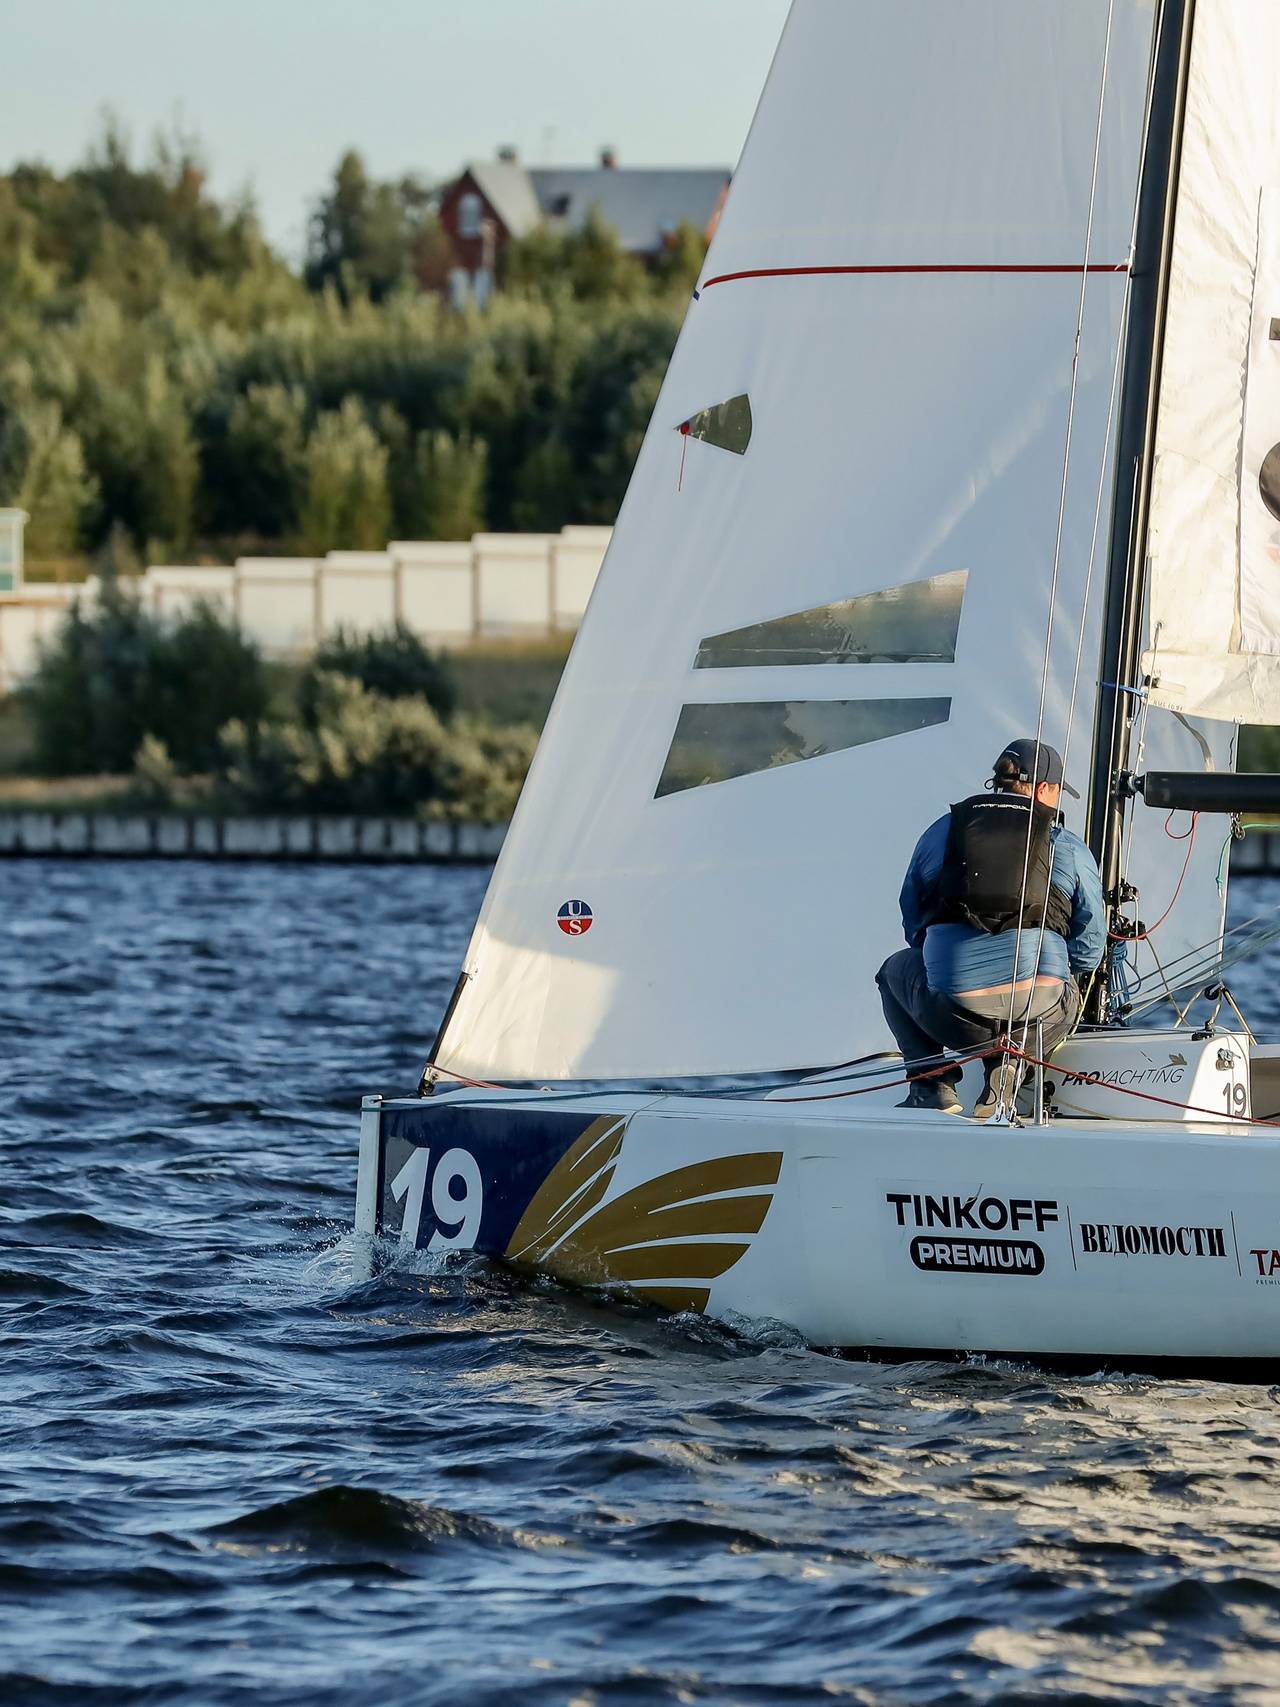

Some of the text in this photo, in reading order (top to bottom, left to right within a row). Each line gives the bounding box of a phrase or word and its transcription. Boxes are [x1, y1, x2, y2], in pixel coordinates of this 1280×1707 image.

[1061, 1068, 1185, 1087] PROYACHTING
[1222, 1083, 1247, 1118] 19
[390, 1147, 484, 1250] 19
[886, 1193, 1059, 1232] TINKOFF
[918, 1242, 1037, 1269] PREMIUM
[1079, 1223, 1228, 1258] ВЕДОМОСТИ
